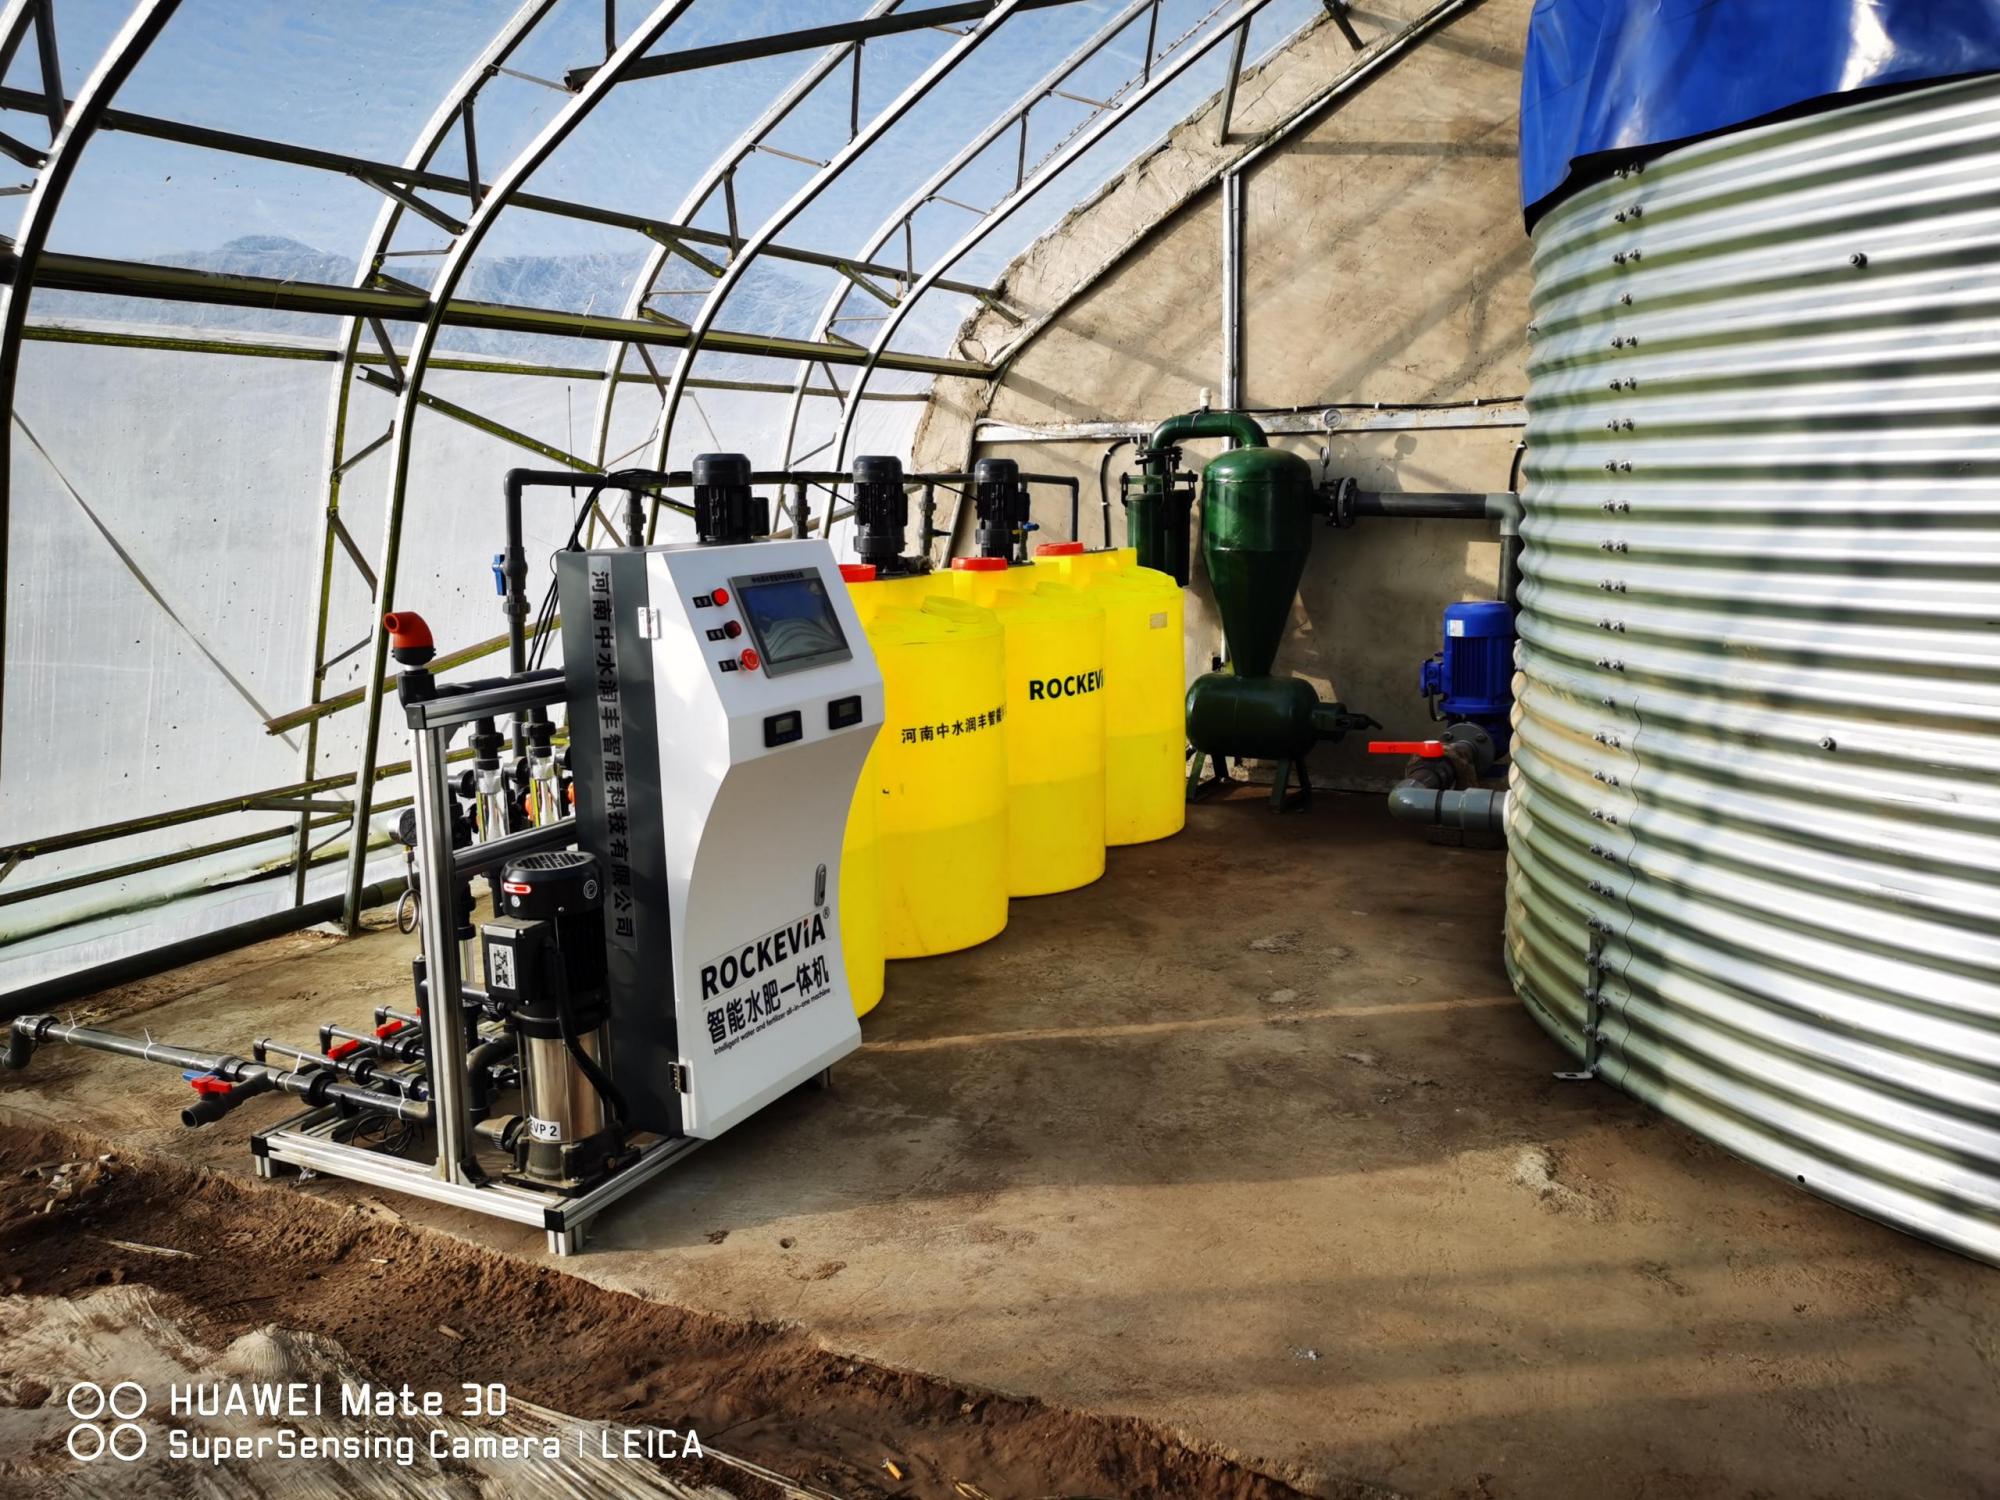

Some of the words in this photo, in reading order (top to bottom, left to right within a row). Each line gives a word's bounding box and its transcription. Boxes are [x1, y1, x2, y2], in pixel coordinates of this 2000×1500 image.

[901, 704, 1004, 744] 河南中水润丰智能
[592, 570, 634, 938] 河南中水润丰智能科技有限公司
[707, 955, 830, 1044] 智能水肥一体机
[740, 1028, 755, 1040] water
[756, 1022, 766, 1032] and
[549, 1125, 557, 1137] 2
